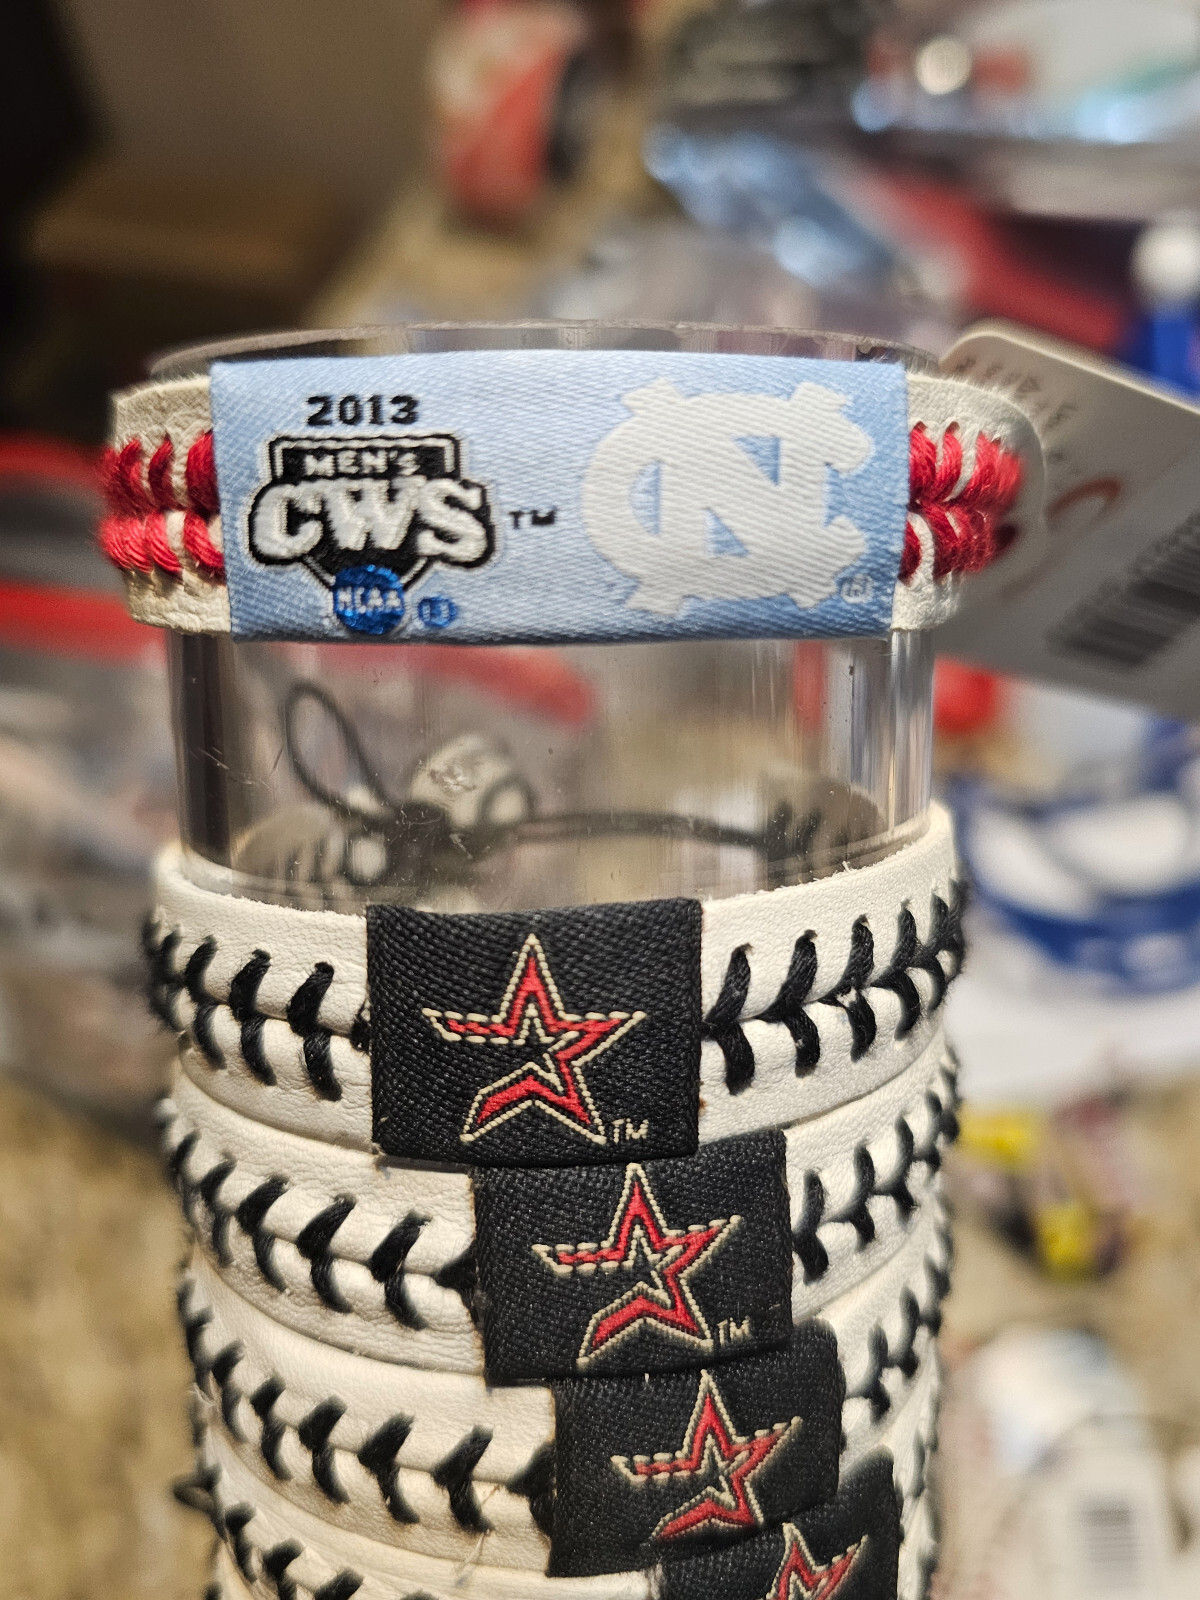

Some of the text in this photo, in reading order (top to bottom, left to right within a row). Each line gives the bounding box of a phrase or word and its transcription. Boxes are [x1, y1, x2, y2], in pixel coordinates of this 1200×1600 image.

[306, 394, 419, 426] 2013
[303, 450, 420, 475] MEN'S
[252, 476, 488, 563] CWS
[337, 586, 402, 614] NCAA
[613, 1118, 649, 1144] TM
[718, 1316, 750, 1347] TM
